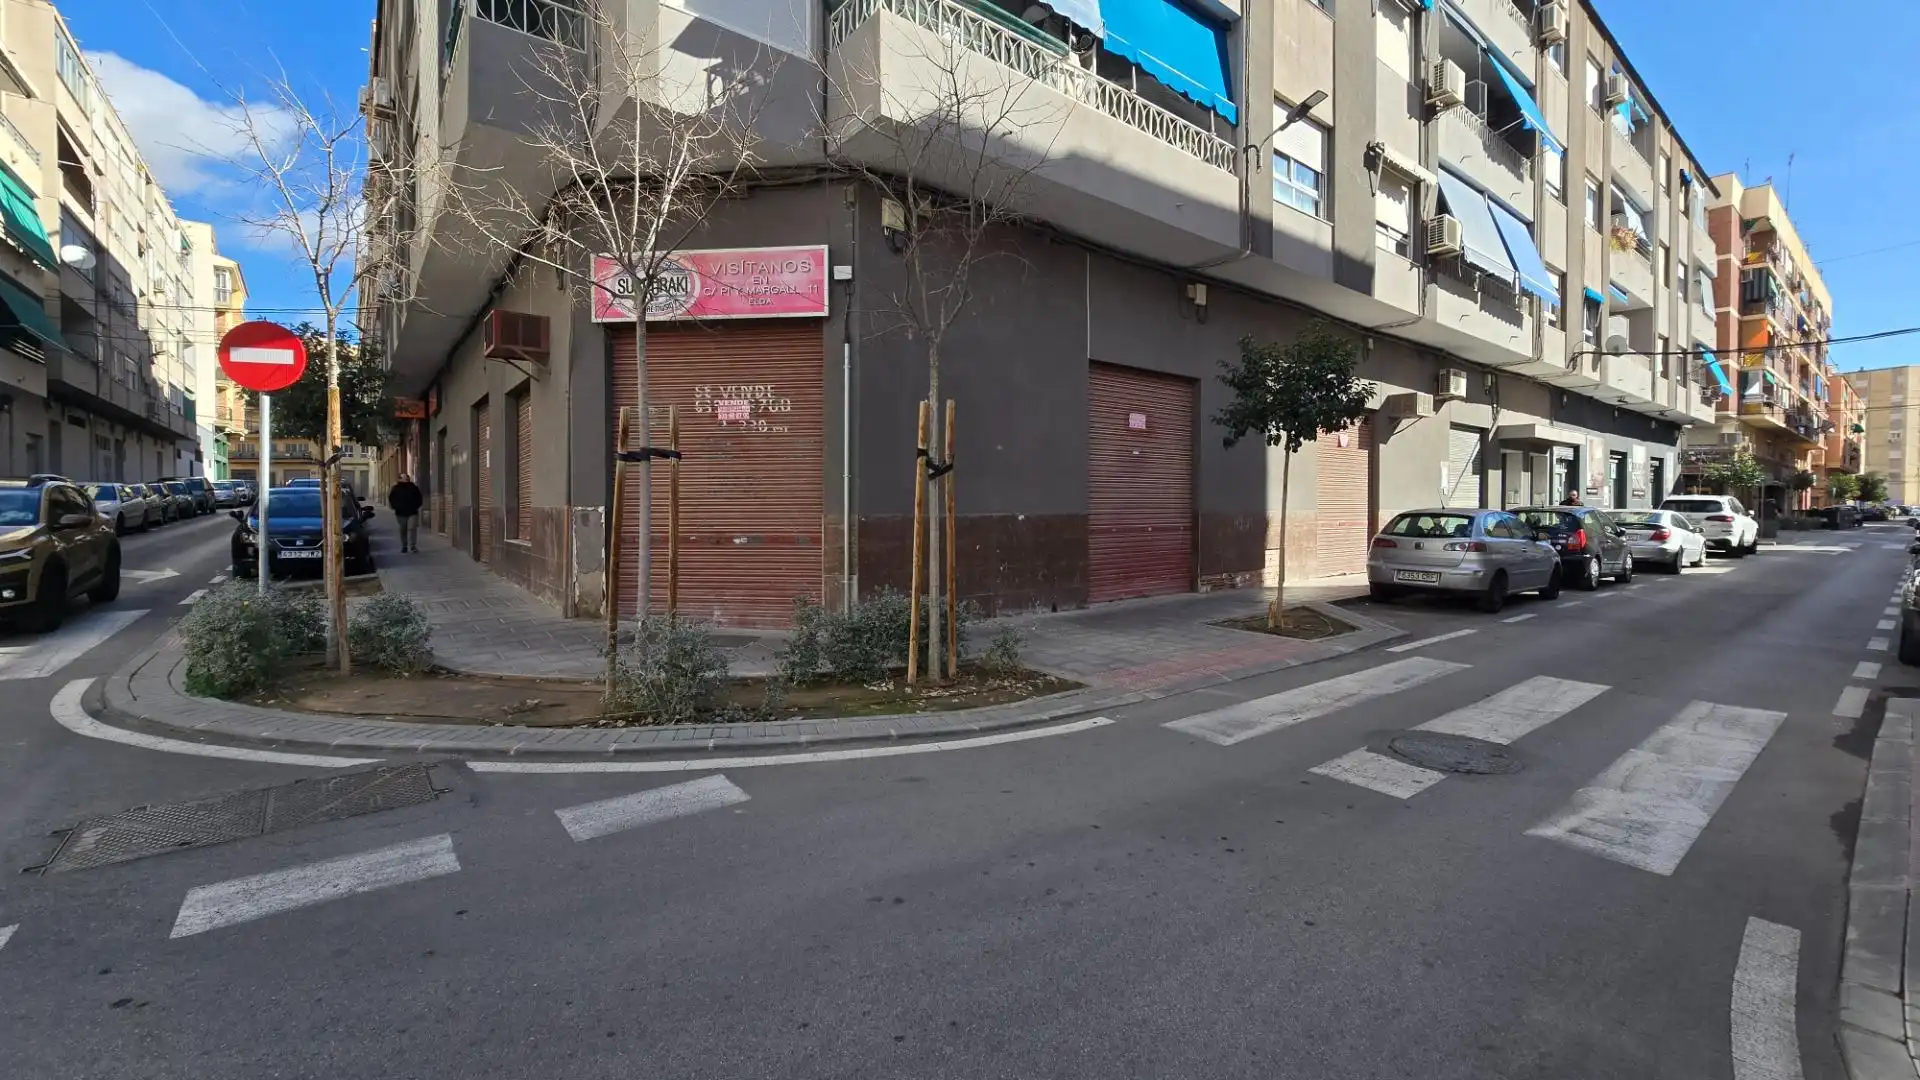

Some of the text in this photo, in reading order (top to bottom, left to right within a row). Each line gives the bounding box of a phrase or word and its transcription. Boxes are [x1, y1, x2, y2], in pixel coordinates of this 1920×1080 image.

[710, 258, 812, 276] VISÍTANOS
[753, 275, 769, 285] EN
[703, 287, 716, 296] C/
[808, 283, 819, 297] 11
[719, 385, 775, 399] VENDE
